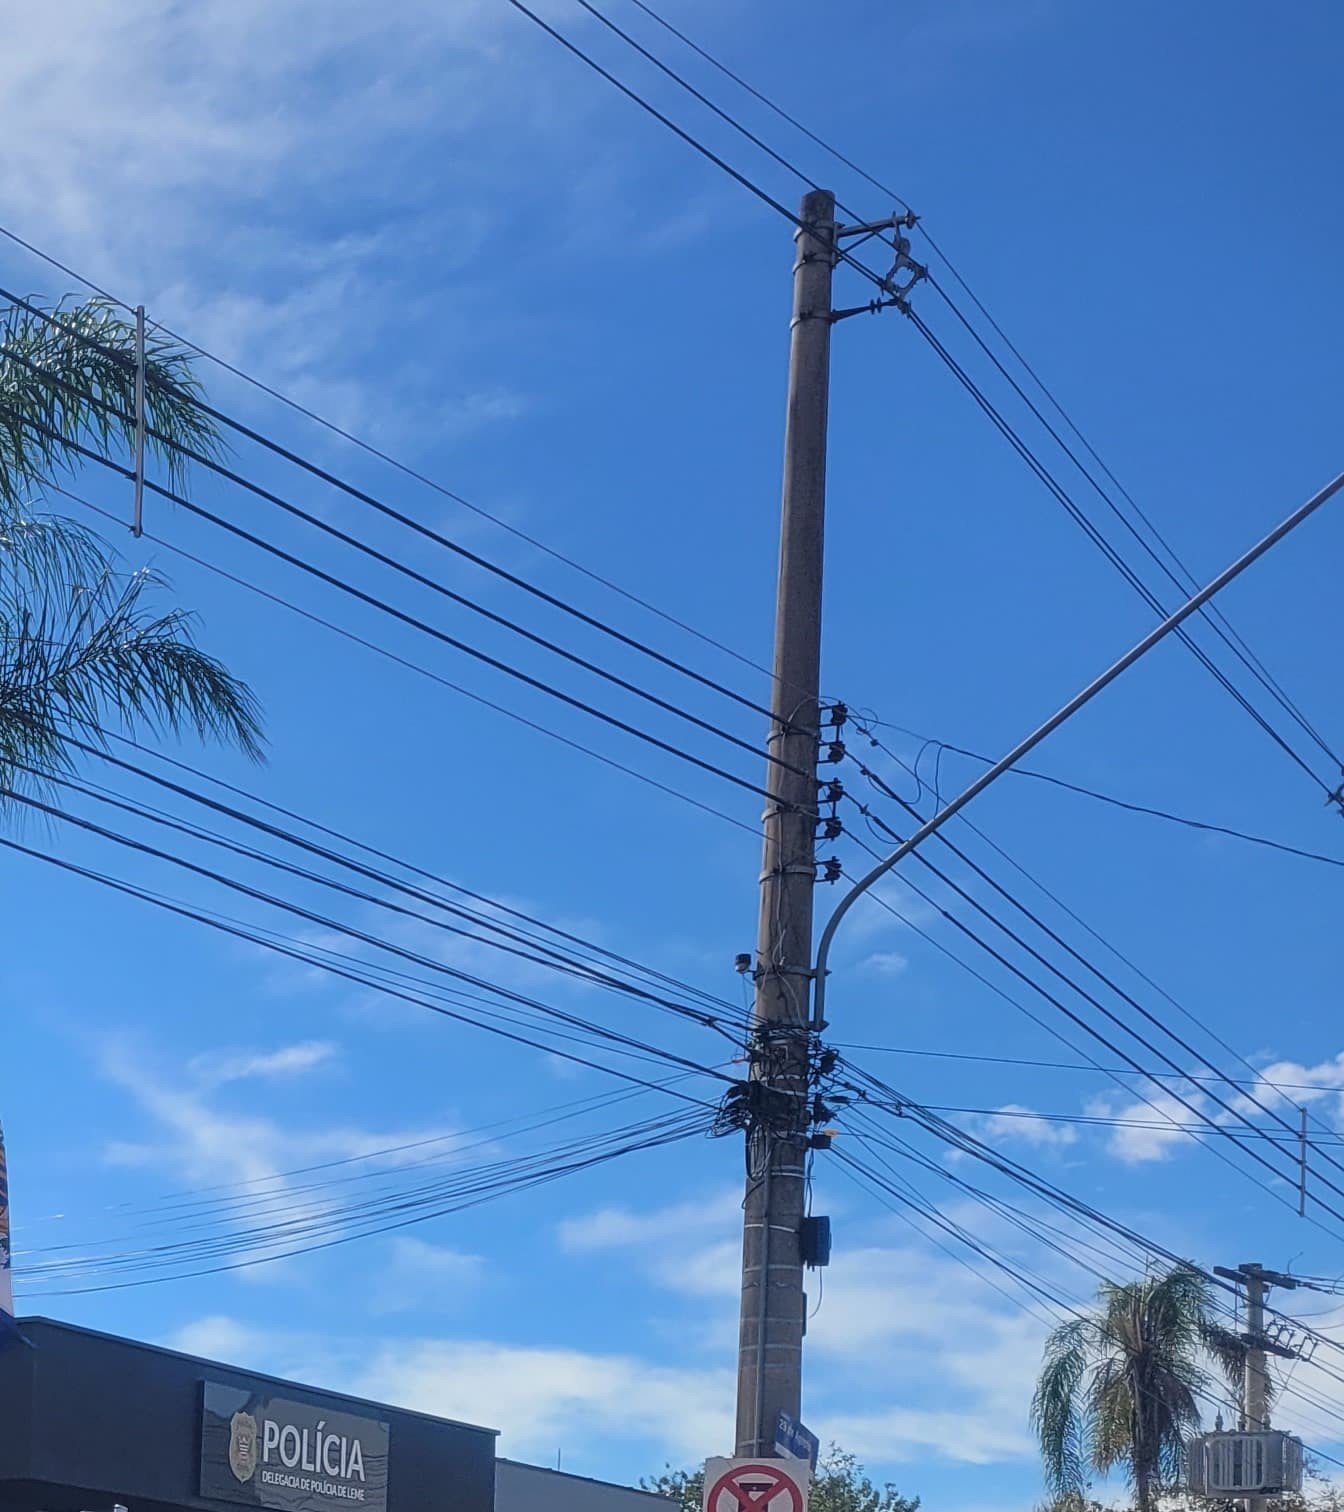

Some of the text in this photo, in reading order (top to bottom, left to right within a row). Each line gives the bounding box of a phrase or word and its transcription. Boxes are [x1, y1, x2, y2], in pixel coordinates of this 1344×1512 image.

[263, 1419, 366, 1482] POLÍCIA
[262, 1470, 300, 1489] DELEGACIA
[300, 1478, 310, 1491] DE
